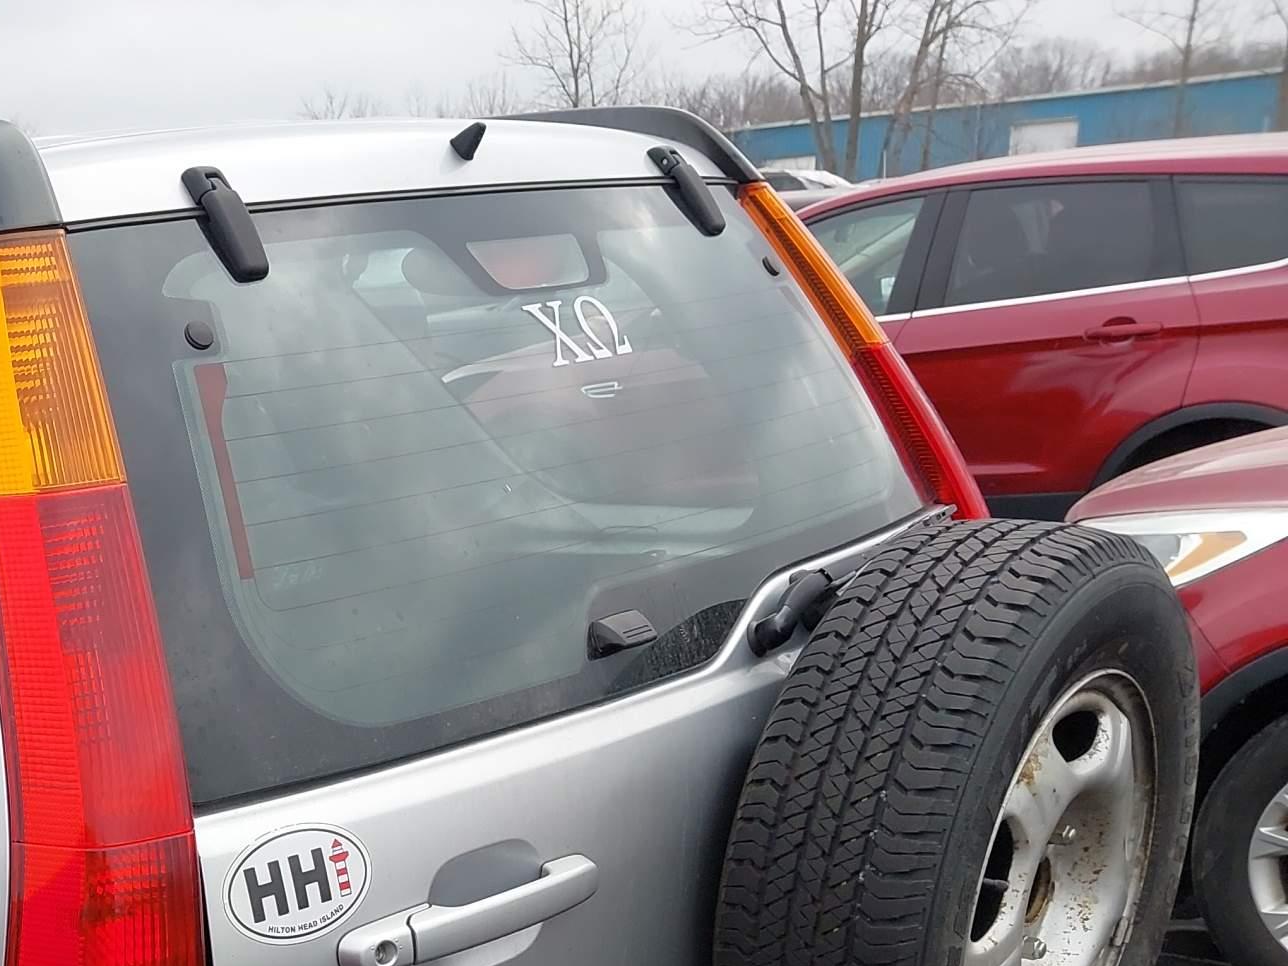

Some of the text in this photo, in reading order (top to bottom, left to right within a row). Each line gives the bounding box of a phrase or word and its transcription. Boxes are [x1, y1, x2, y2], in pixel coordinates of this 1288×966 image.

[268, 904, 344, 934] HILTON HEAD ISLAND
